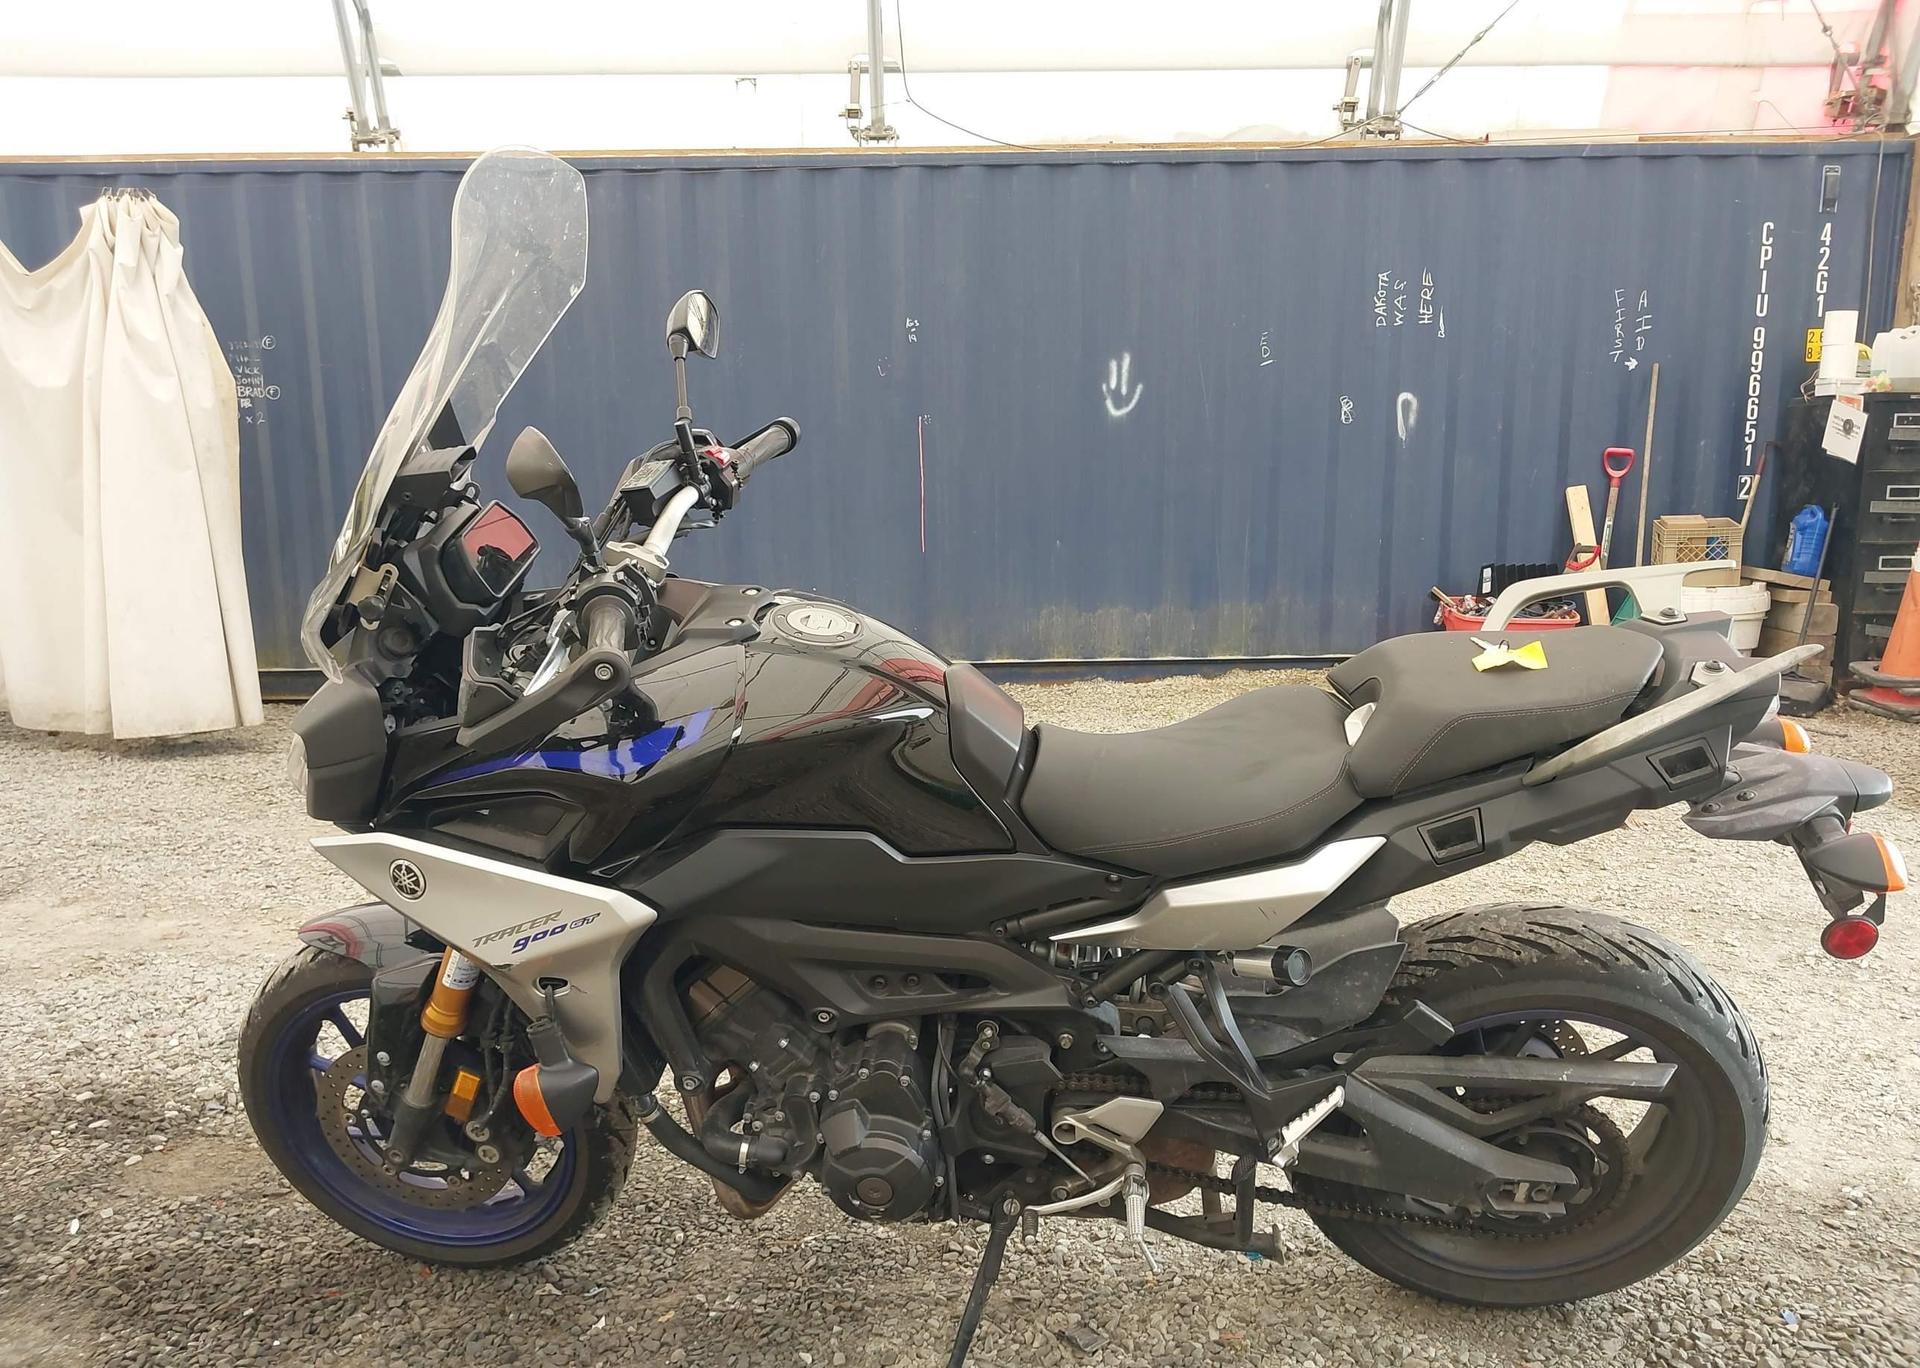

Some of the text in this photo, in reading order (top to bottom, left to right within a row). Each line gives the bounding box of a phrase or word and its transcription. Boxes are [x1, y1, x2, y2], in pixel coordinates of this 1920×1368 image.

[1373, 270, 1392, 328] DAKOTA
[1418, 266, 1435, 324] HERE
[1815, 222, 1832, 318] 42G1
[1609, 288, 1653, 363] FIRST AID
[1739, 221, 1775, 499] CPIU 996651 2
[237, 386, 265, 398] BRAD
[472, 909, 563, 948] TRACER
[511, 911, 601, 954] 900 GT
